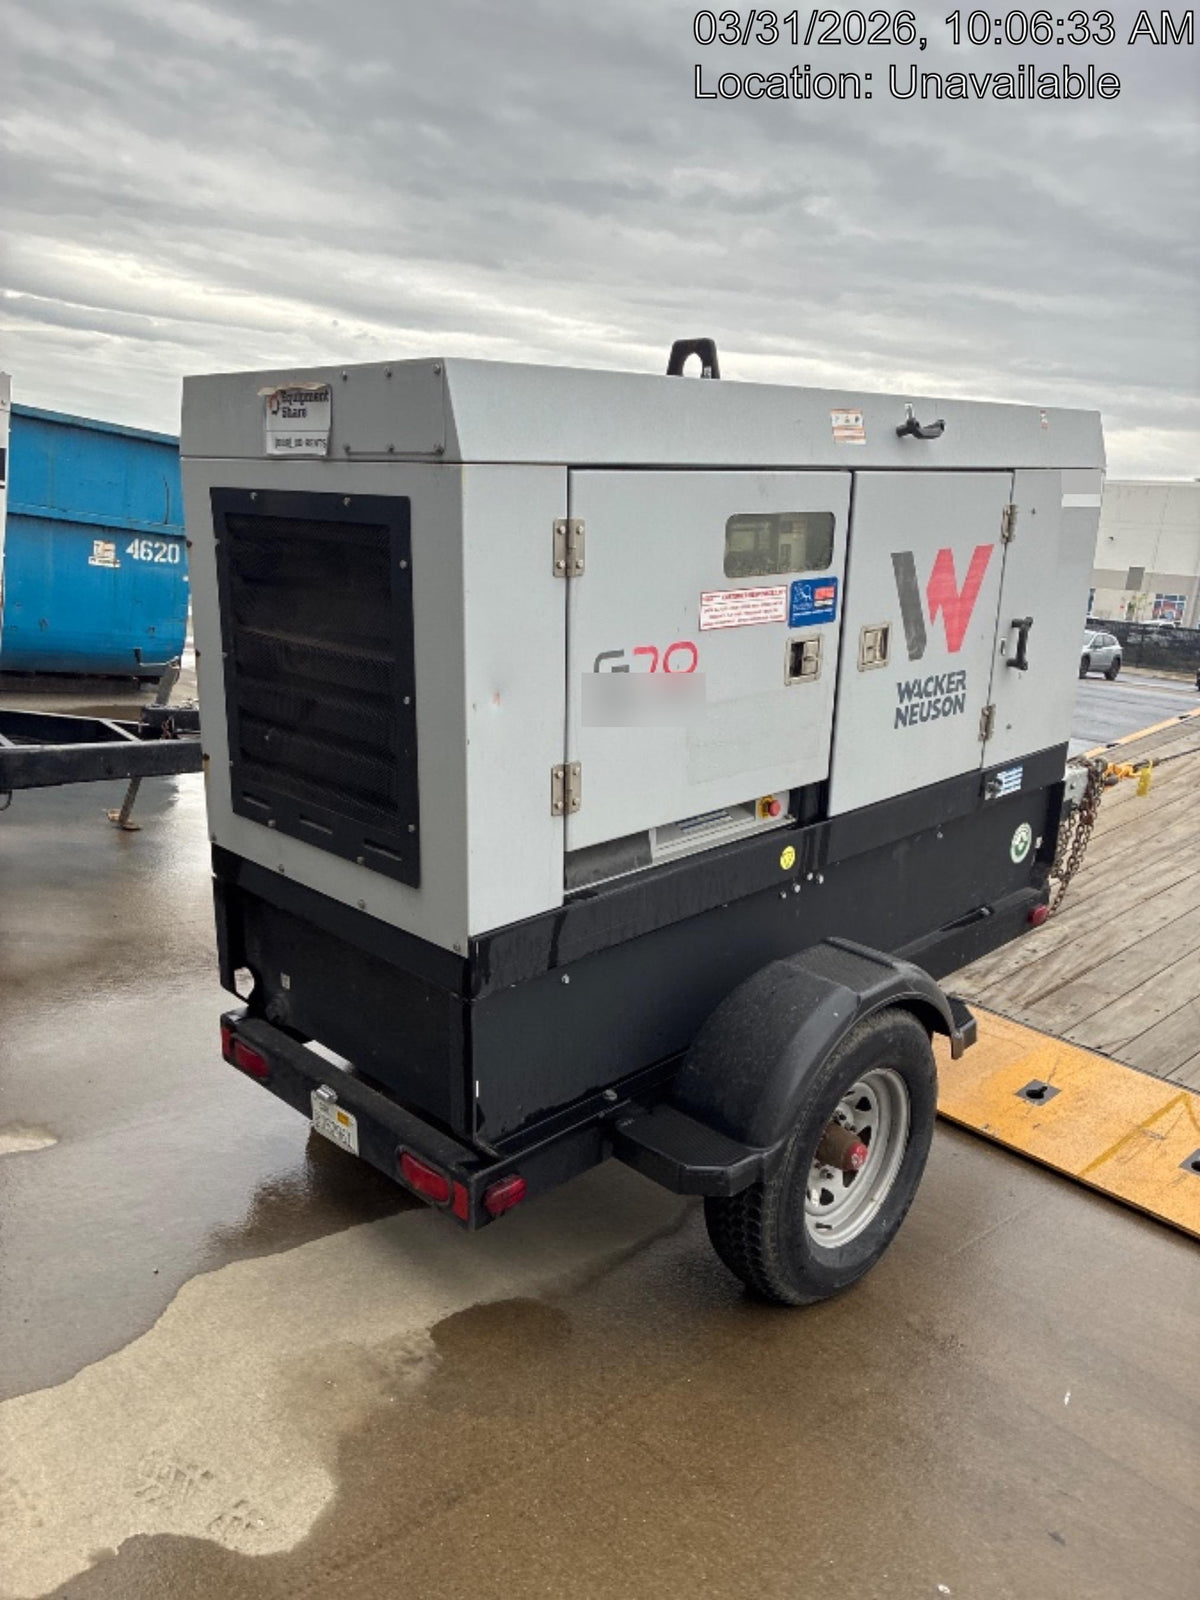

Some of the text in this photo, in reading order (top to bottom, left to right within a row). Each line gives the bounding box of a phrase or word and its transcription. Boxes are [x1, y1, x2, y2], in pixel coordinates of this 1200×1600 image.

[282, 407, 308, 418] Share
[125, 538, 180, 564] 4620
[897, 670, 966, 704] WACKER
[893, 693, 966, 729] NEUSON
